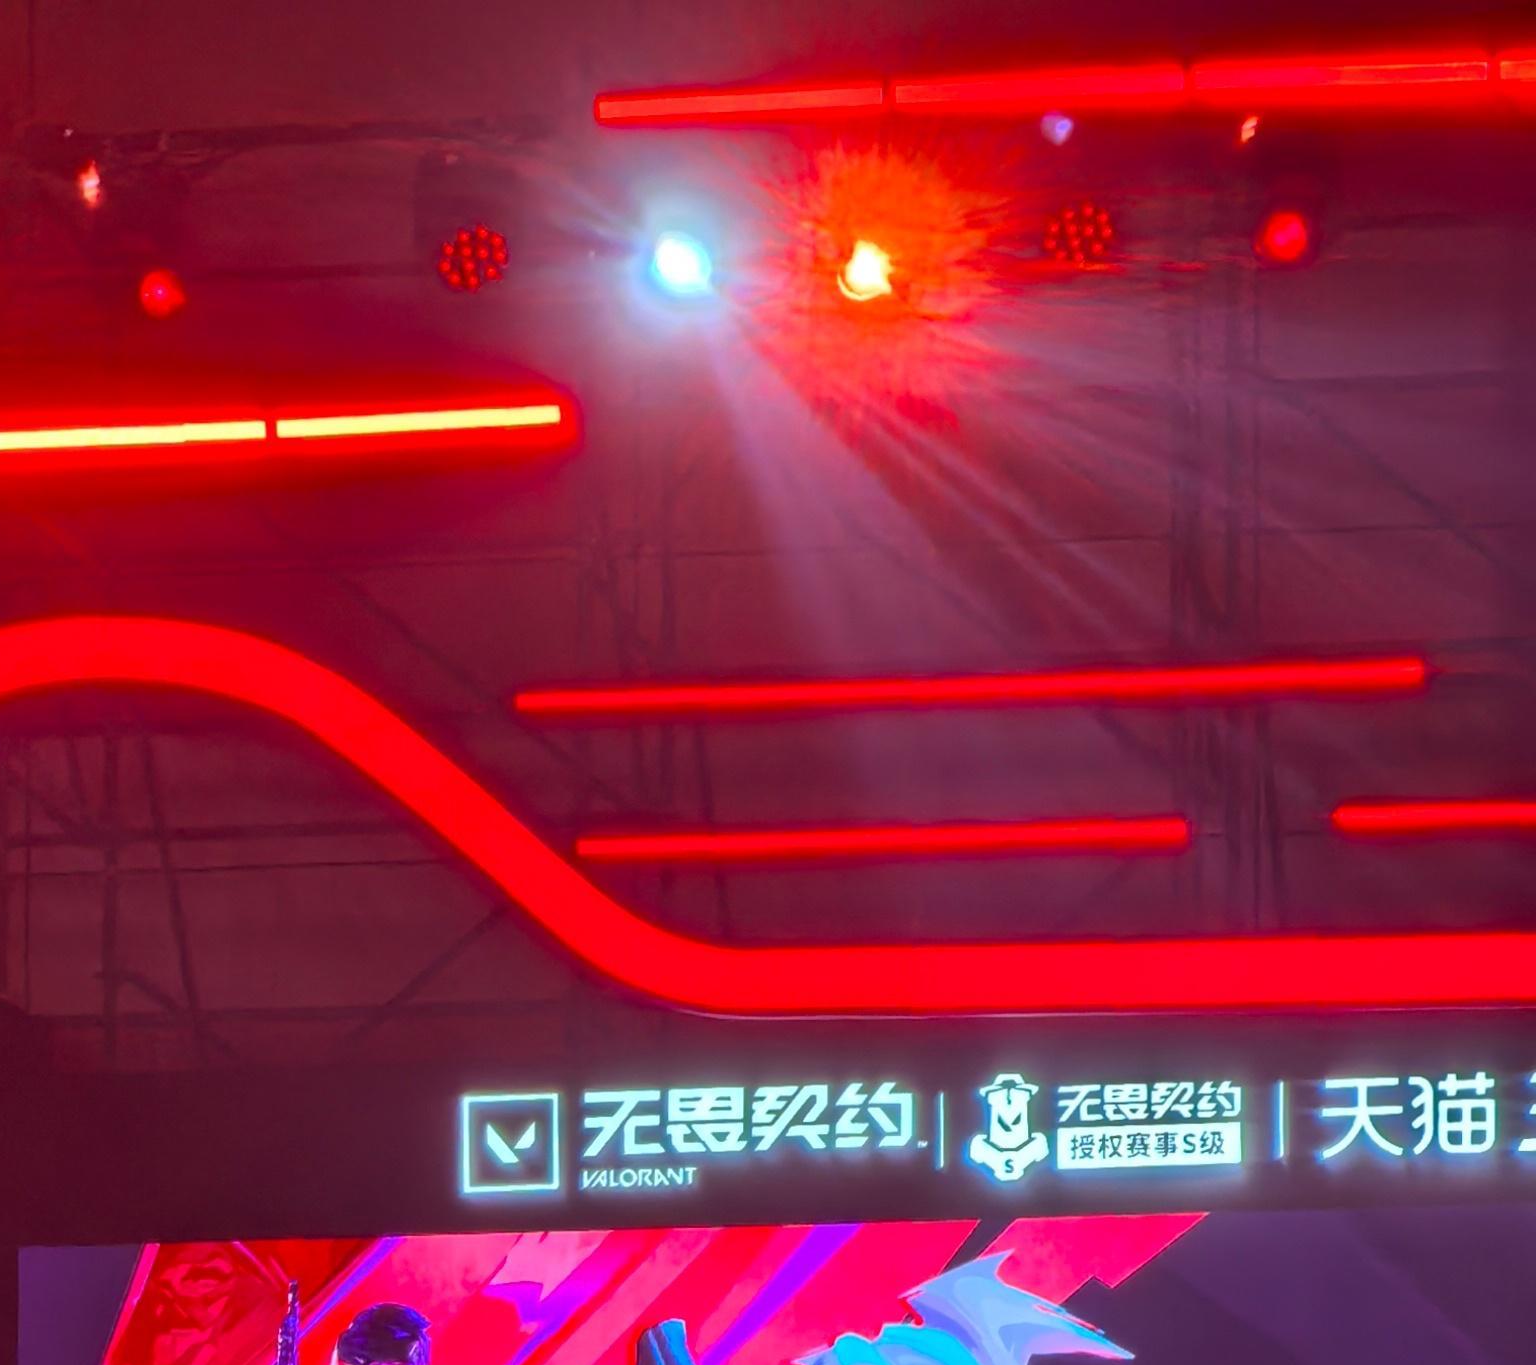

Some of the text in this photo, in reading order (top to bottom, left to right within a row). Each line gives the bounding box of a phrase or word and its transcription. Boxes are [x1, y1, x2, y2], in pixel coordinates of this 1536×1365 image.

[583, 1082, 913, 1157] 无畏契约
[1056, 1080, 1242, 1122] 无畏契约
[1320, 1071, 1536, 1159] 天猫
[1071, 1130, 1224, 1160] 授权赛事S级
[582, 1166, 697, 1189] VALORANT
